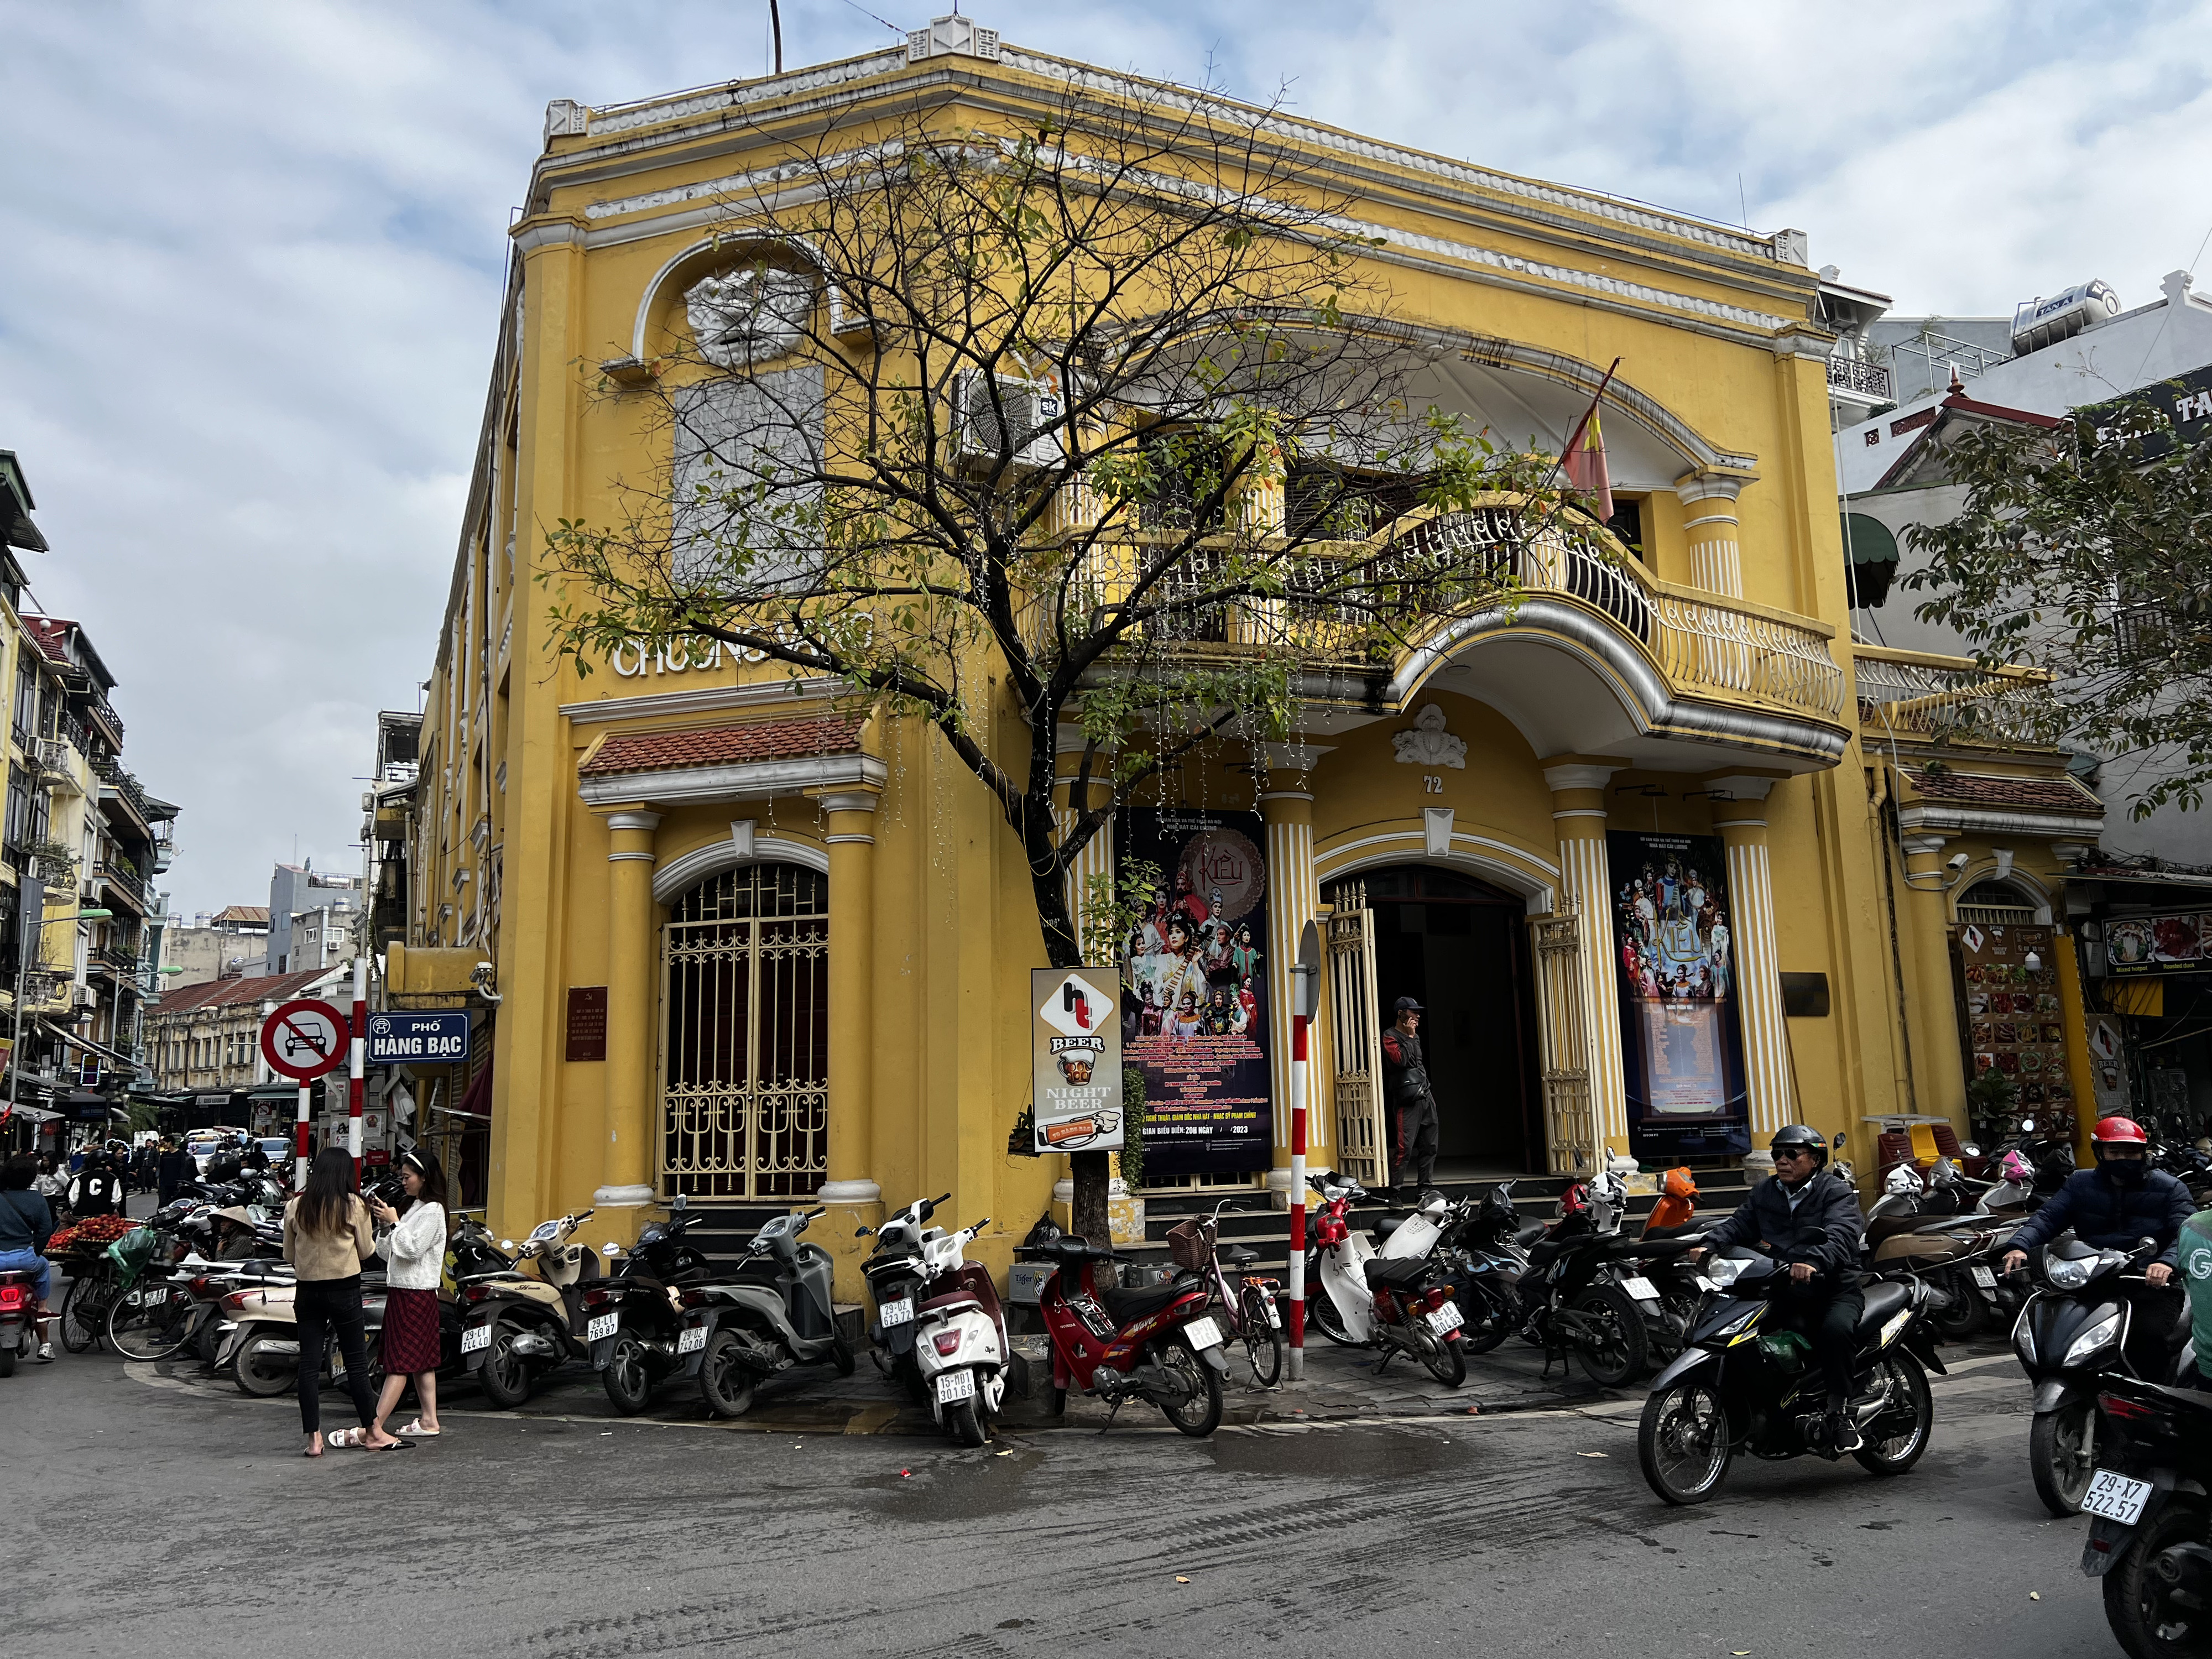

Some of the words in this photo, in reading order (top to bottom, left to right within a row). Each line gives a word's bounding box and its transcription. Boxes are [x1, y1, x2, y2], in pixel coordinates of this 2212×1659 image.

[2176, 388, 2212, 422] TA
[1423, 775, 1443, 794] 72
[1063, 982, 1092, 1030] ht
[411, 1019, 442, 1031] PHỐ
[374, 1034, 422, 1055] HÀNG
[427, 1036, 462, 1056] BẠC
[1051, 1037, 1104, 1052] BEER
[1046, 1087, 1111, 1099] NIGHT
[1054, 1098, 1103, 1110] BEER
[1198, 1124, 1213, 1134] NGÀY
[89, 1178, 102, 1196] C
[1015, 1274, 1032, 1285] Tiger
[592, 1314, 613, 1329] 29-L1
[884, 1310, 911, 1327] 623.72
[1431, 1305, 1454, 1323] 15-AA
[589, 1323, 615, 1340] 769.87
[1133, 1313, 1161, 1333] Wave
[466, 1327, 486, 1342] 29-C1
[463, 1336, 488, 1353] 744.40
[680, 1338, 704, 1353] 742.06
[940, 1383, 973, 1401] 301.69
[2096, 1474, 2143, 1499] 29-X7
[2084, 1491, 2139, 1520] 522.57
